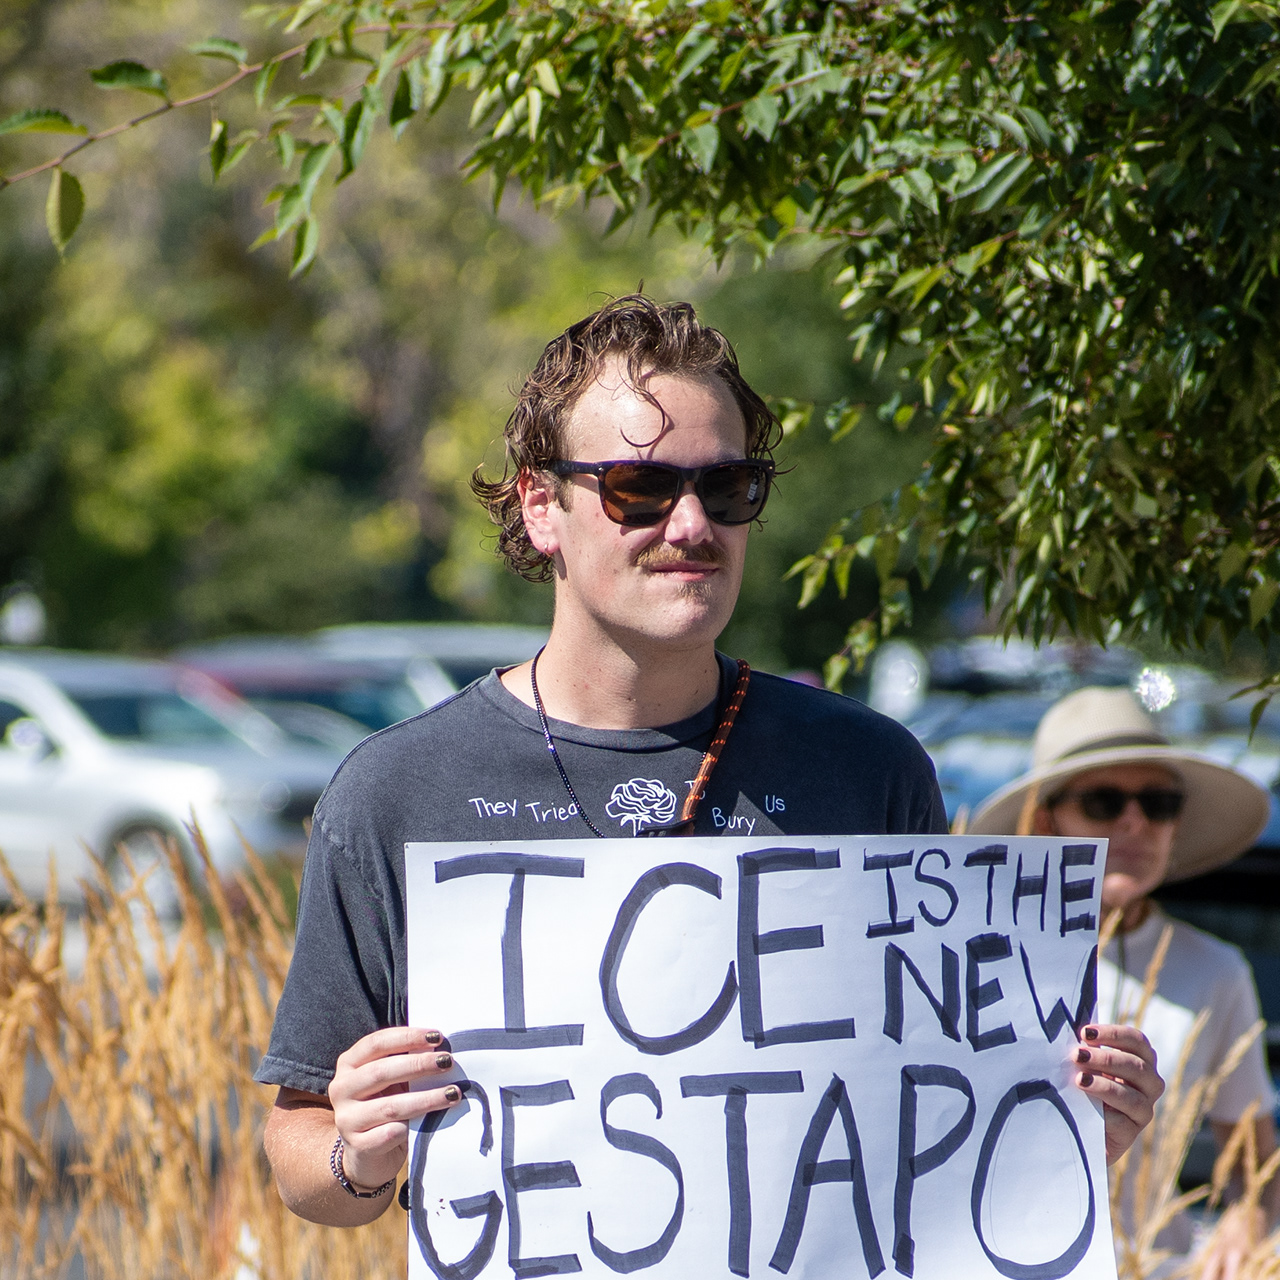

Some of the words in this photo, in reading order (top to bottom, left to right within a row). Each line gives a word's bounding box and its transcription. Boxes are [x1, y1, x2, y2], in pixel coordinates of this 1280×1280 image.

[468, 797, 518, 818] They
[711, 806, 756, 836] Bury
[765, 794, 786, 813] Us
[863, 847, 960, 939] IS
[963, 844, 1098, 934] THE
[434, 847, 856, 1056] ICE
[883, 933, 1099, 1052] NEW
